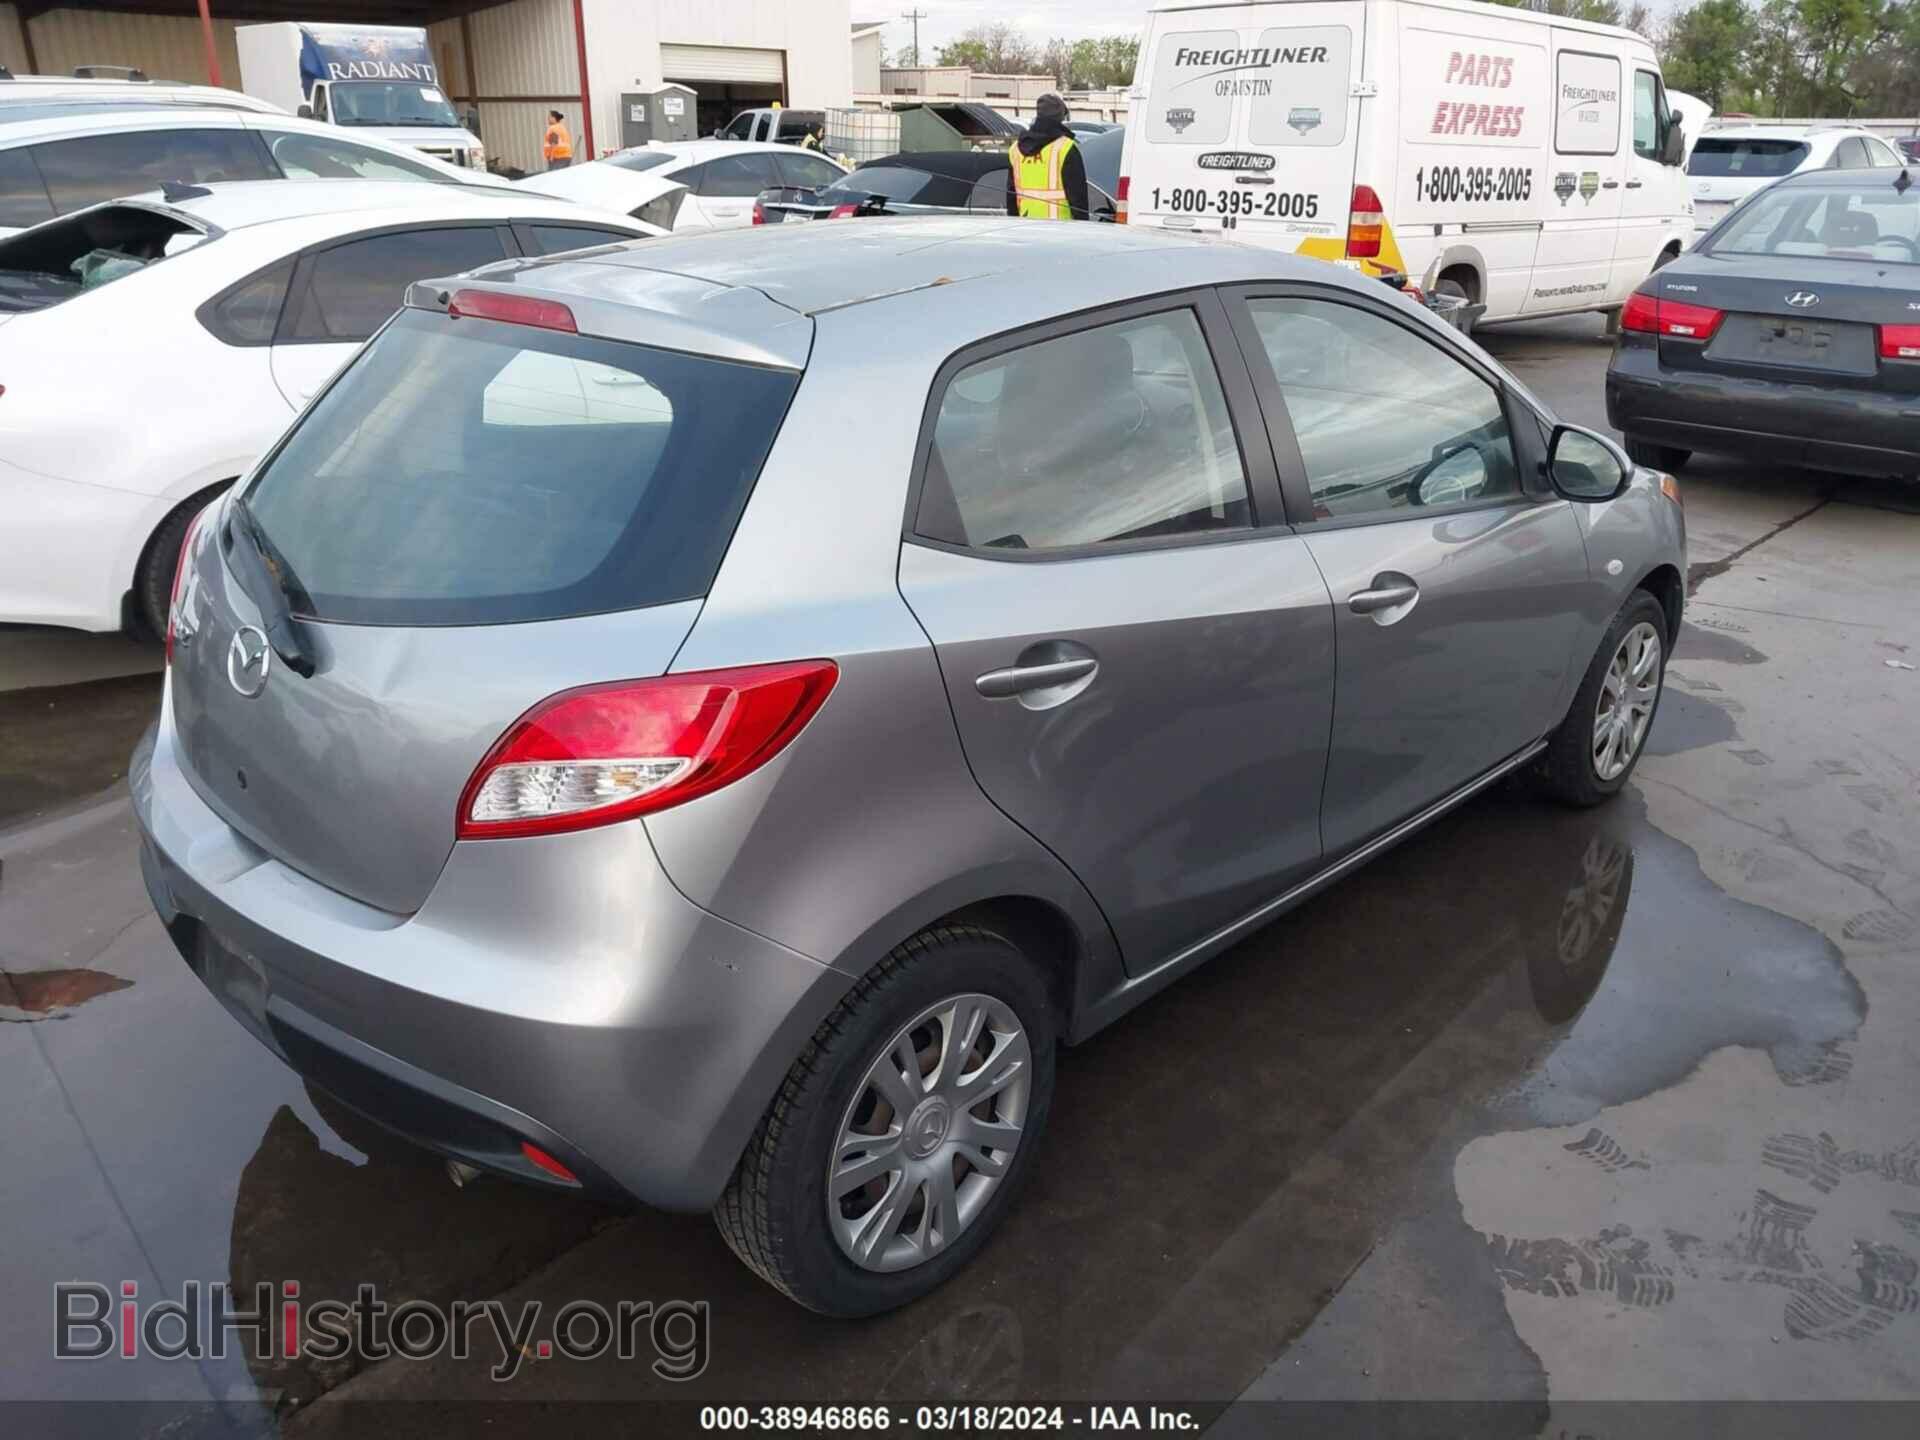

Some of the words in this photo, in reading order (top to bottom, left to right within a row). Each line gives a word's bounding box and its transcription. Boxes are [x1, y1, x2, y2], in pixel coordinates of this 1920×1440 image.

[1175, 47, 1328, 66] FREIGHTLINER
[328, 60, 432, 81] RADIANT
[1445, 51, 1514, 88] PARTS
[1230, 79, 1273, 96] AUSTIN
[1562, 84, 1616, 101] FREIGHTLINER
[1430, 101, 1525, 137] EXPRESS
[1200, 154, 1274, 169] FREIGHTLINER
[1416, 165, 1532, 202] 1-800-395-2005
[1152, 187, 1318, 218] 1-800-395-2005
